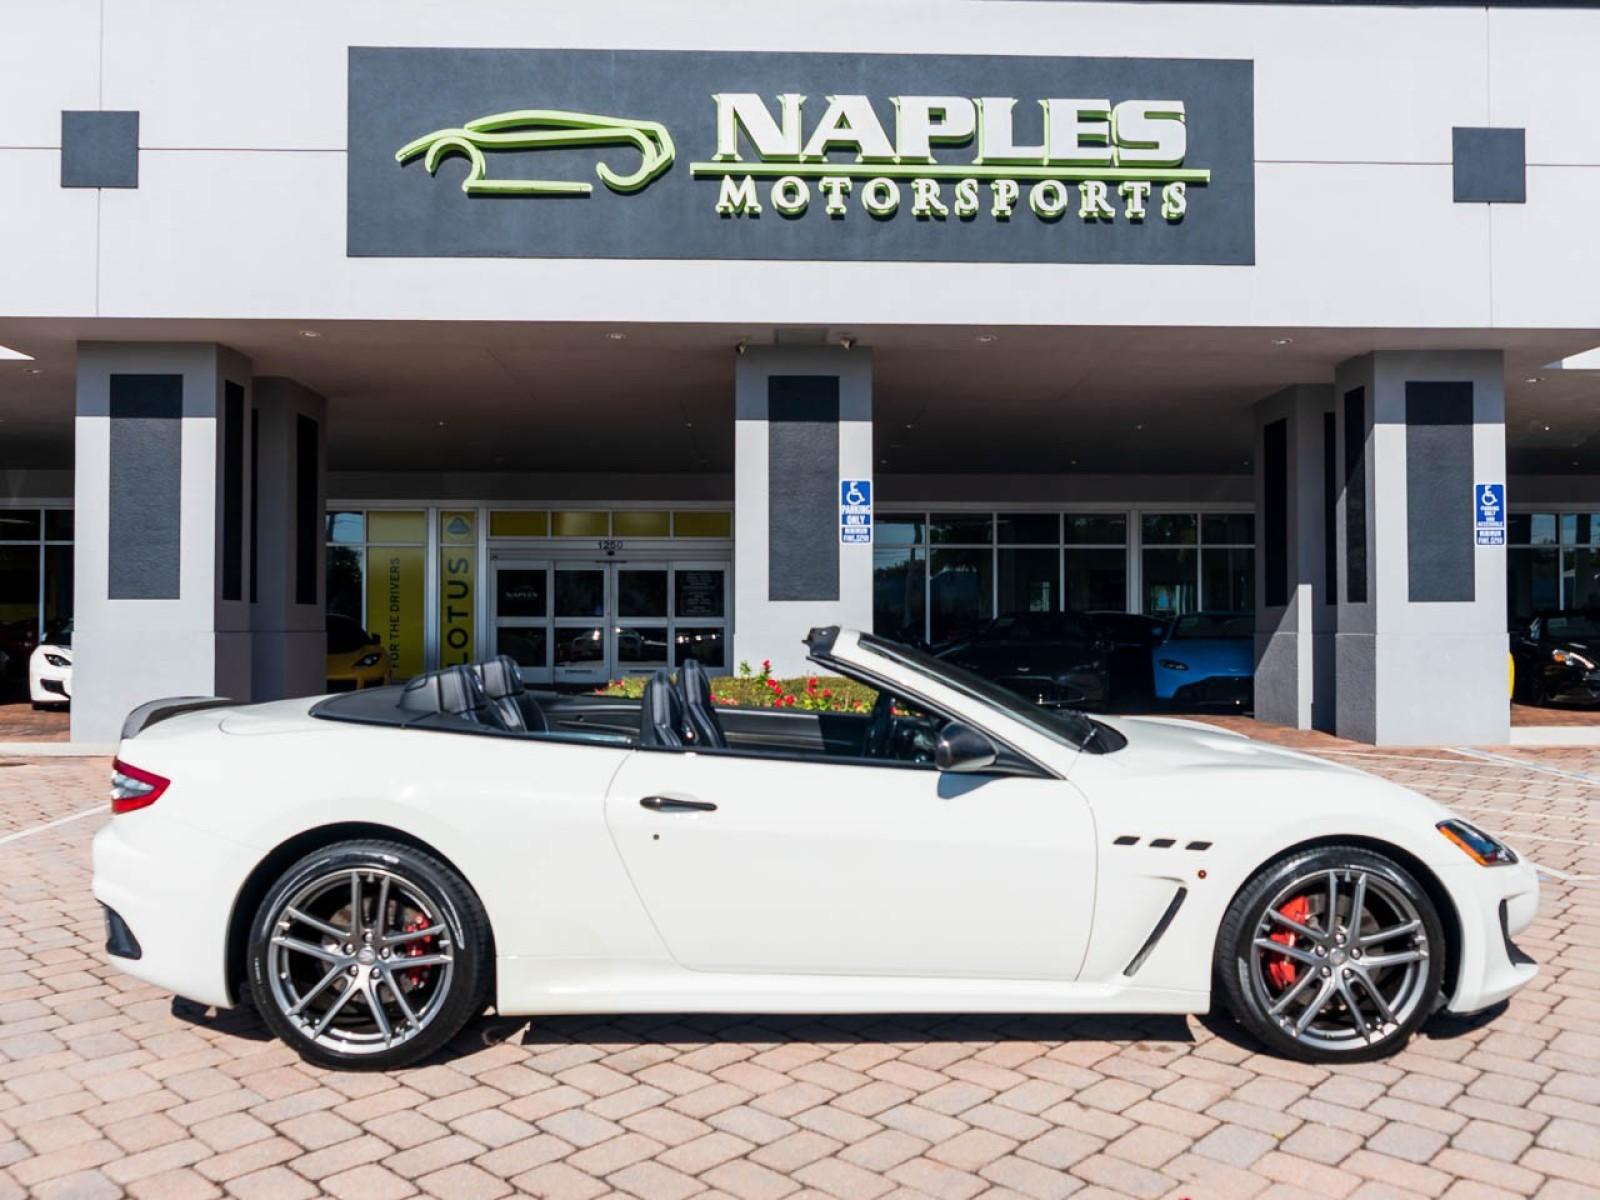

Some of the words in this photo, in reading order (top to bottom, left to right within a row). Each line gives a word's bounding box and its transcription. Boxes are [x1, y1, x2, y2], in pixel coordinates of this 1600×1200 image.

[713, 92, 1187, 167] NAPLES
[714, 174, 1188, 220] MOTORSPORTS
[840, 505, 871, 514] PARKING
[847, 515, 866, 525] ONLY
[598, 540, 624, 550] 1250
[389, 557, 400, 613] DRIVERS
[447, 557, 469, 667] LOTUS
[389, 615, 400, 641] THE
[389, 642, 400, 669] FOR
